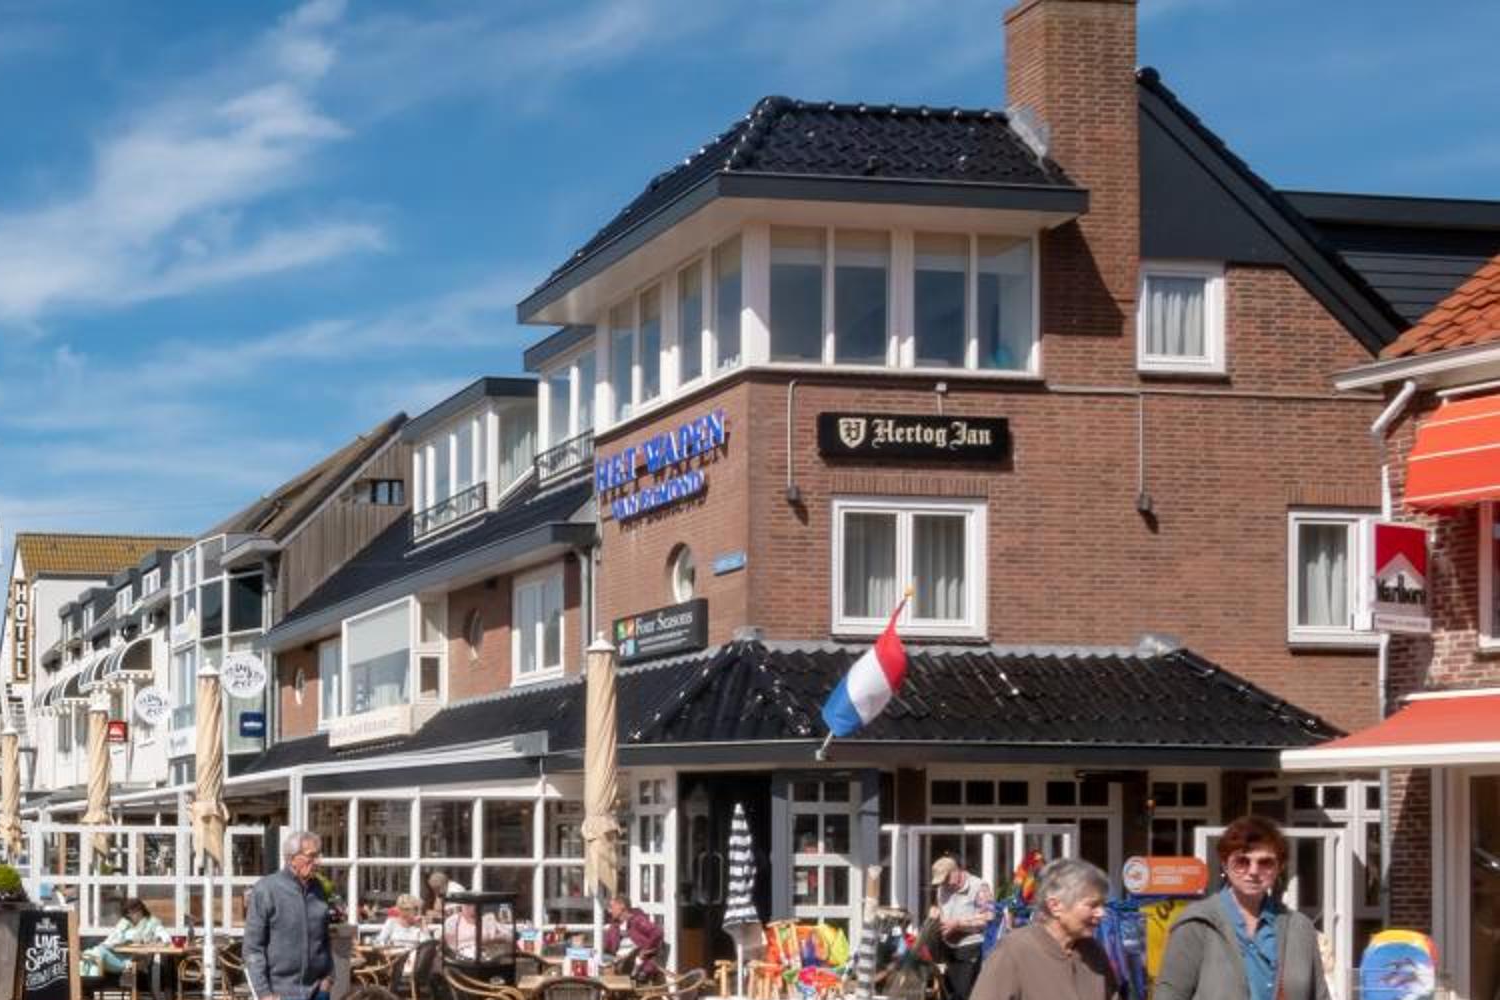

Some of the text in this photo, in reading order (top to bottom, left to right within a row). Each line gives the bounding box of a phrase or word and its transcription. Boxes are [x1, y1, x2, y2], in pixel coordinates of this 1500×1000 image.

[871, 418, 993, 450] Hertog Jan
[15, 583, 28, 679] HOTEL
[635, 609, 693, 637] Four Seasons
